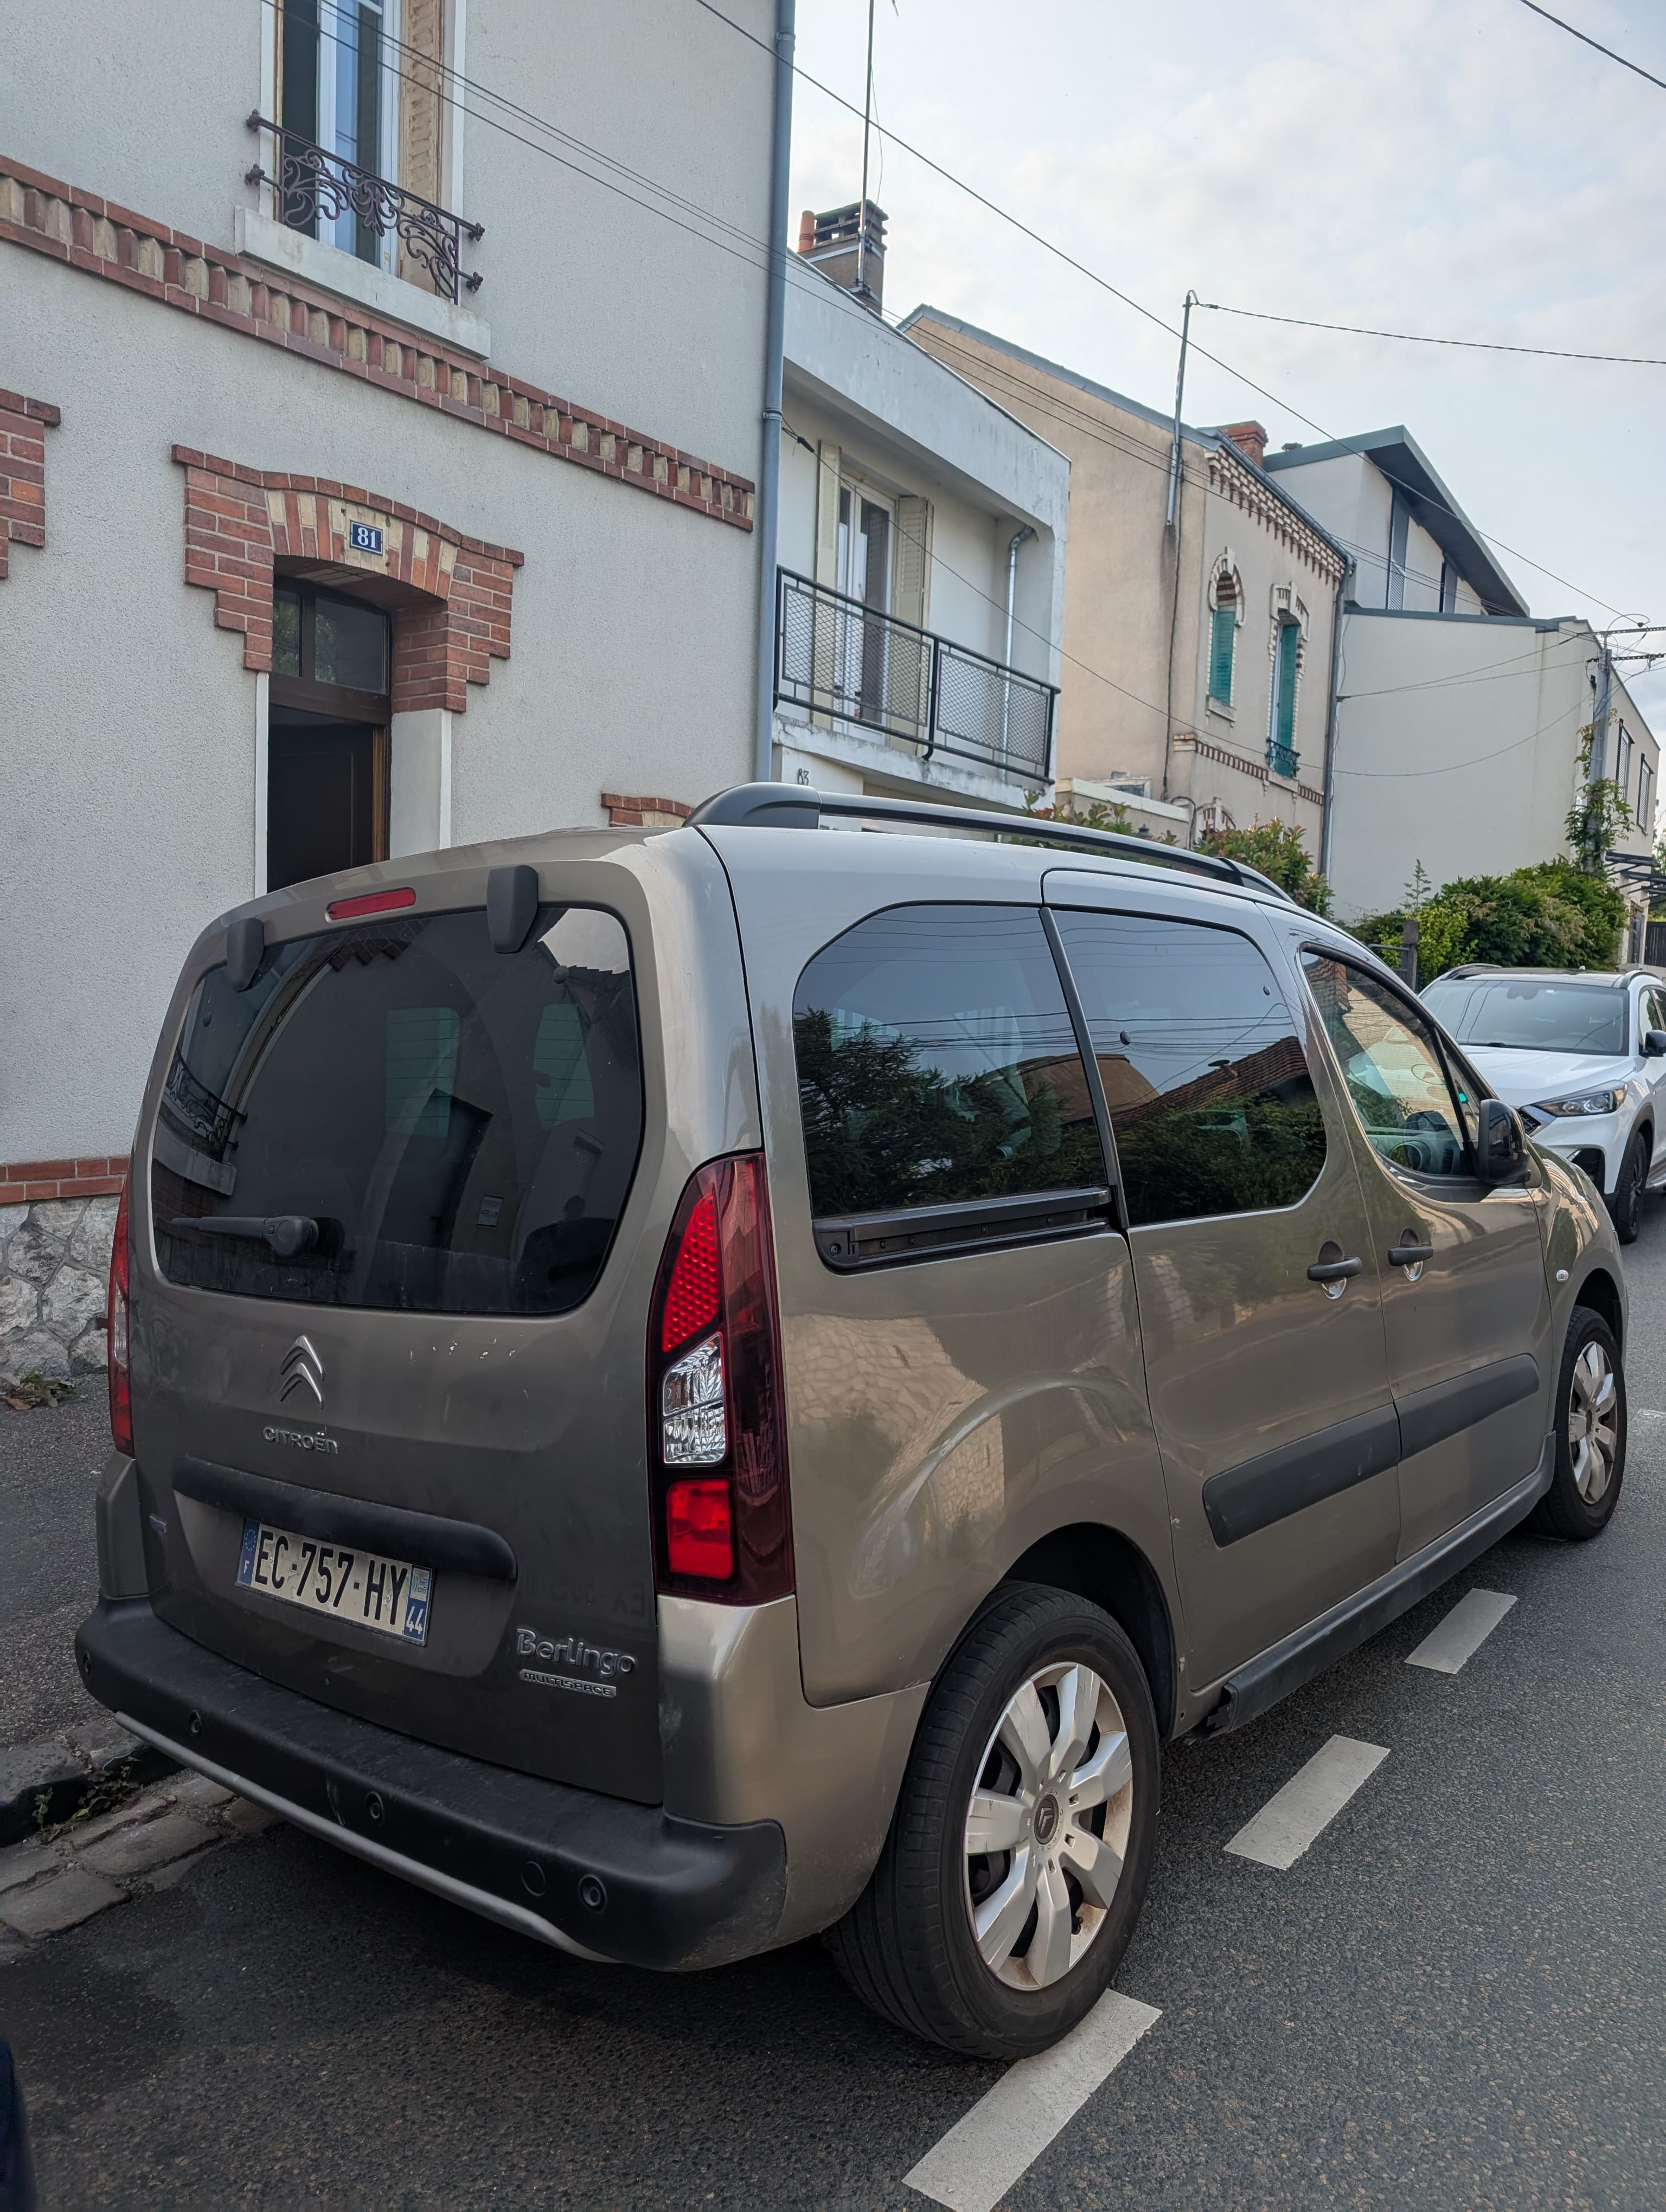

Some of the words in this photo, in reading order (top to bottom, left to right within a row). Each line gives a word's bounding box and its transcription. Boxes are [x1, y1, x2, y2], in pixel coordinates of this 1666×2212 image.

[357, 527, 376, 549] 81
[797, 768, 809, 786] 83
[243, 1560, 249, 1574] F
[254, 1529, 408, 1625] EC-757-HY
[405, 1605, 424, 1635] 44
[516, 1628, 637, 1679] Berlingo
[524, 1672, 612, 1696] MULTISPACE
